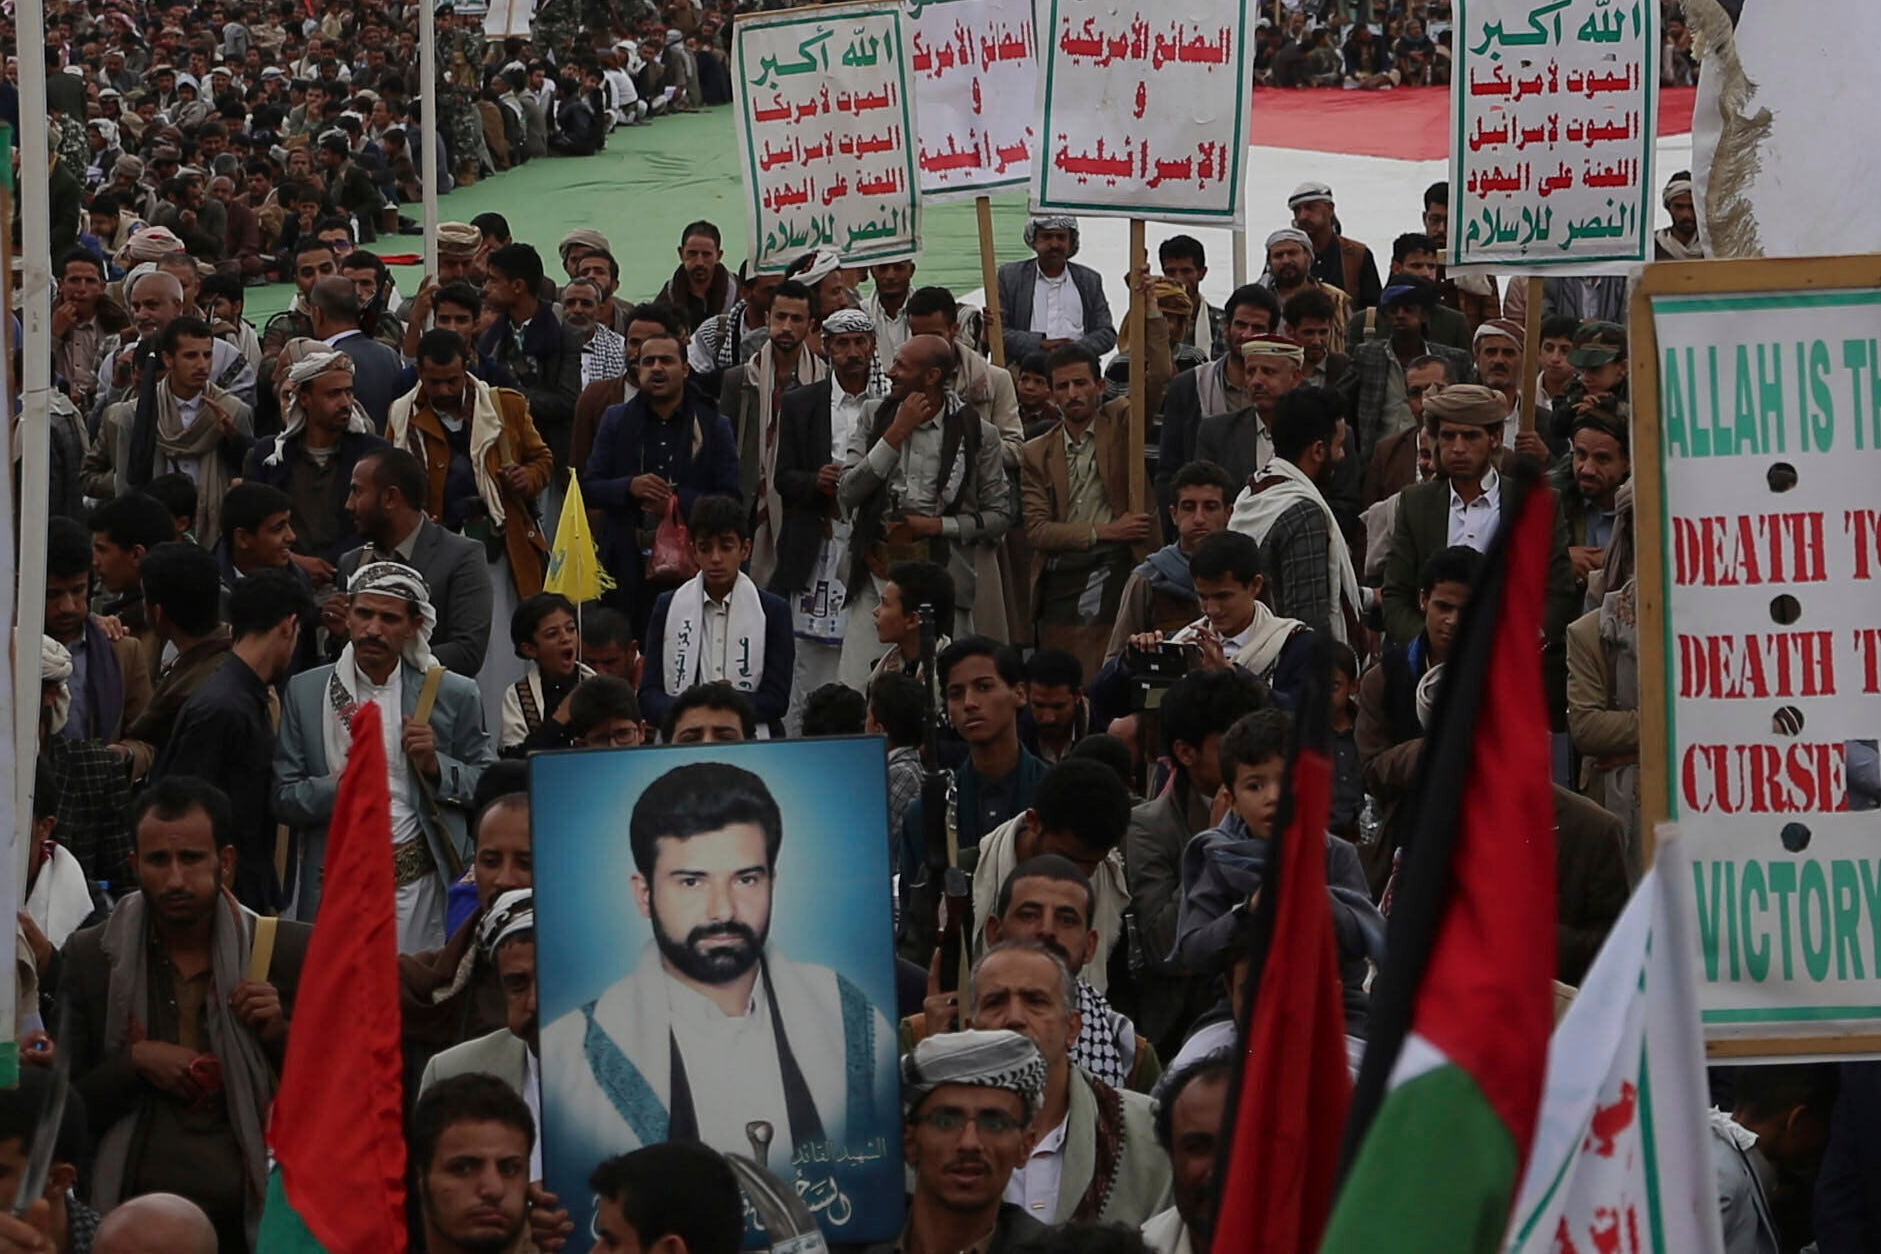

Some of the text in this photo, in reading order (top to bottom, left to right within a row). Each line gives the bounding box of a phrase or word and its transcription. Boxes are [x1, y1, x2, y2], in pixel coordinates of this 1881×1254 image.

[750, 25, 892, 90] الله أكبر
[981, 19, 1032, 73] البضائع
[1060, 12, 1231, 73] البضائع الأمريكية
[753, 82, 897, 125] الموت لأمريكا
[972, 76, 982, 115] و
[1134, 80, 1147, 119] و
[1470, 57, 1639, 101] الموت لأمريكا
[760, 125, 901, 171] الموت لإسرائيل
[1469, 110, 1639, 151] الموت لإسرائيل
[1054, 133, 1227, 190] الإسرائيلية
[1467, 157, 1638, 199] اللعنة على اليهود
[763, 167, 905, 213] اللعنة على اليهود
[842, 204, 907, 251] النصر
[1466, 198, 1636, 255] النصر للإسلام
[1664, 344, 1786, 458] ALLAH
[1797, 340, 1834, 453] IS
[1672, 511, 1827, 587] DEATH
[1678, 632, 1836, 699] DEATH
[1681, 743, 1849, 814] CURSE
